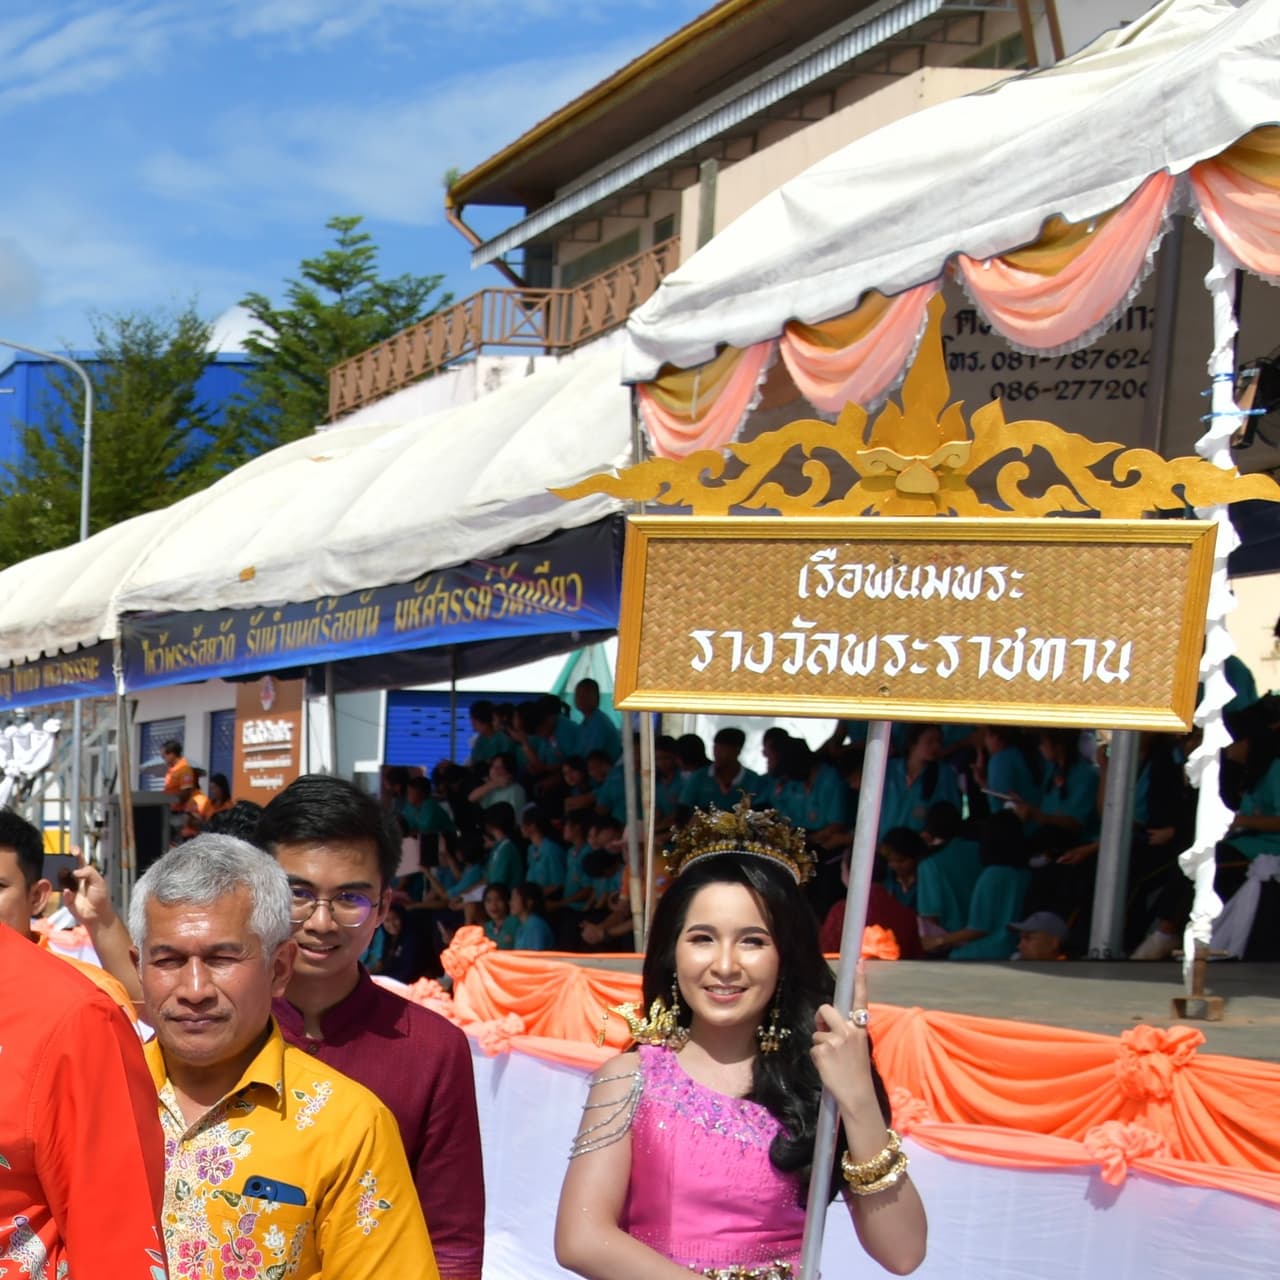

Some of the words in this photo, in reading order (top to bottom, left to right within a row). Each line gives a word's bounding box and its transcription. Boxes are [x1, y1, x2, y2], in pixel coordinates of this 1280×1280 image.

[797, 547, 1026, 602] เรือพนมพระ
[688, 615, 1133, 684] รางวัลพระราชทาน
